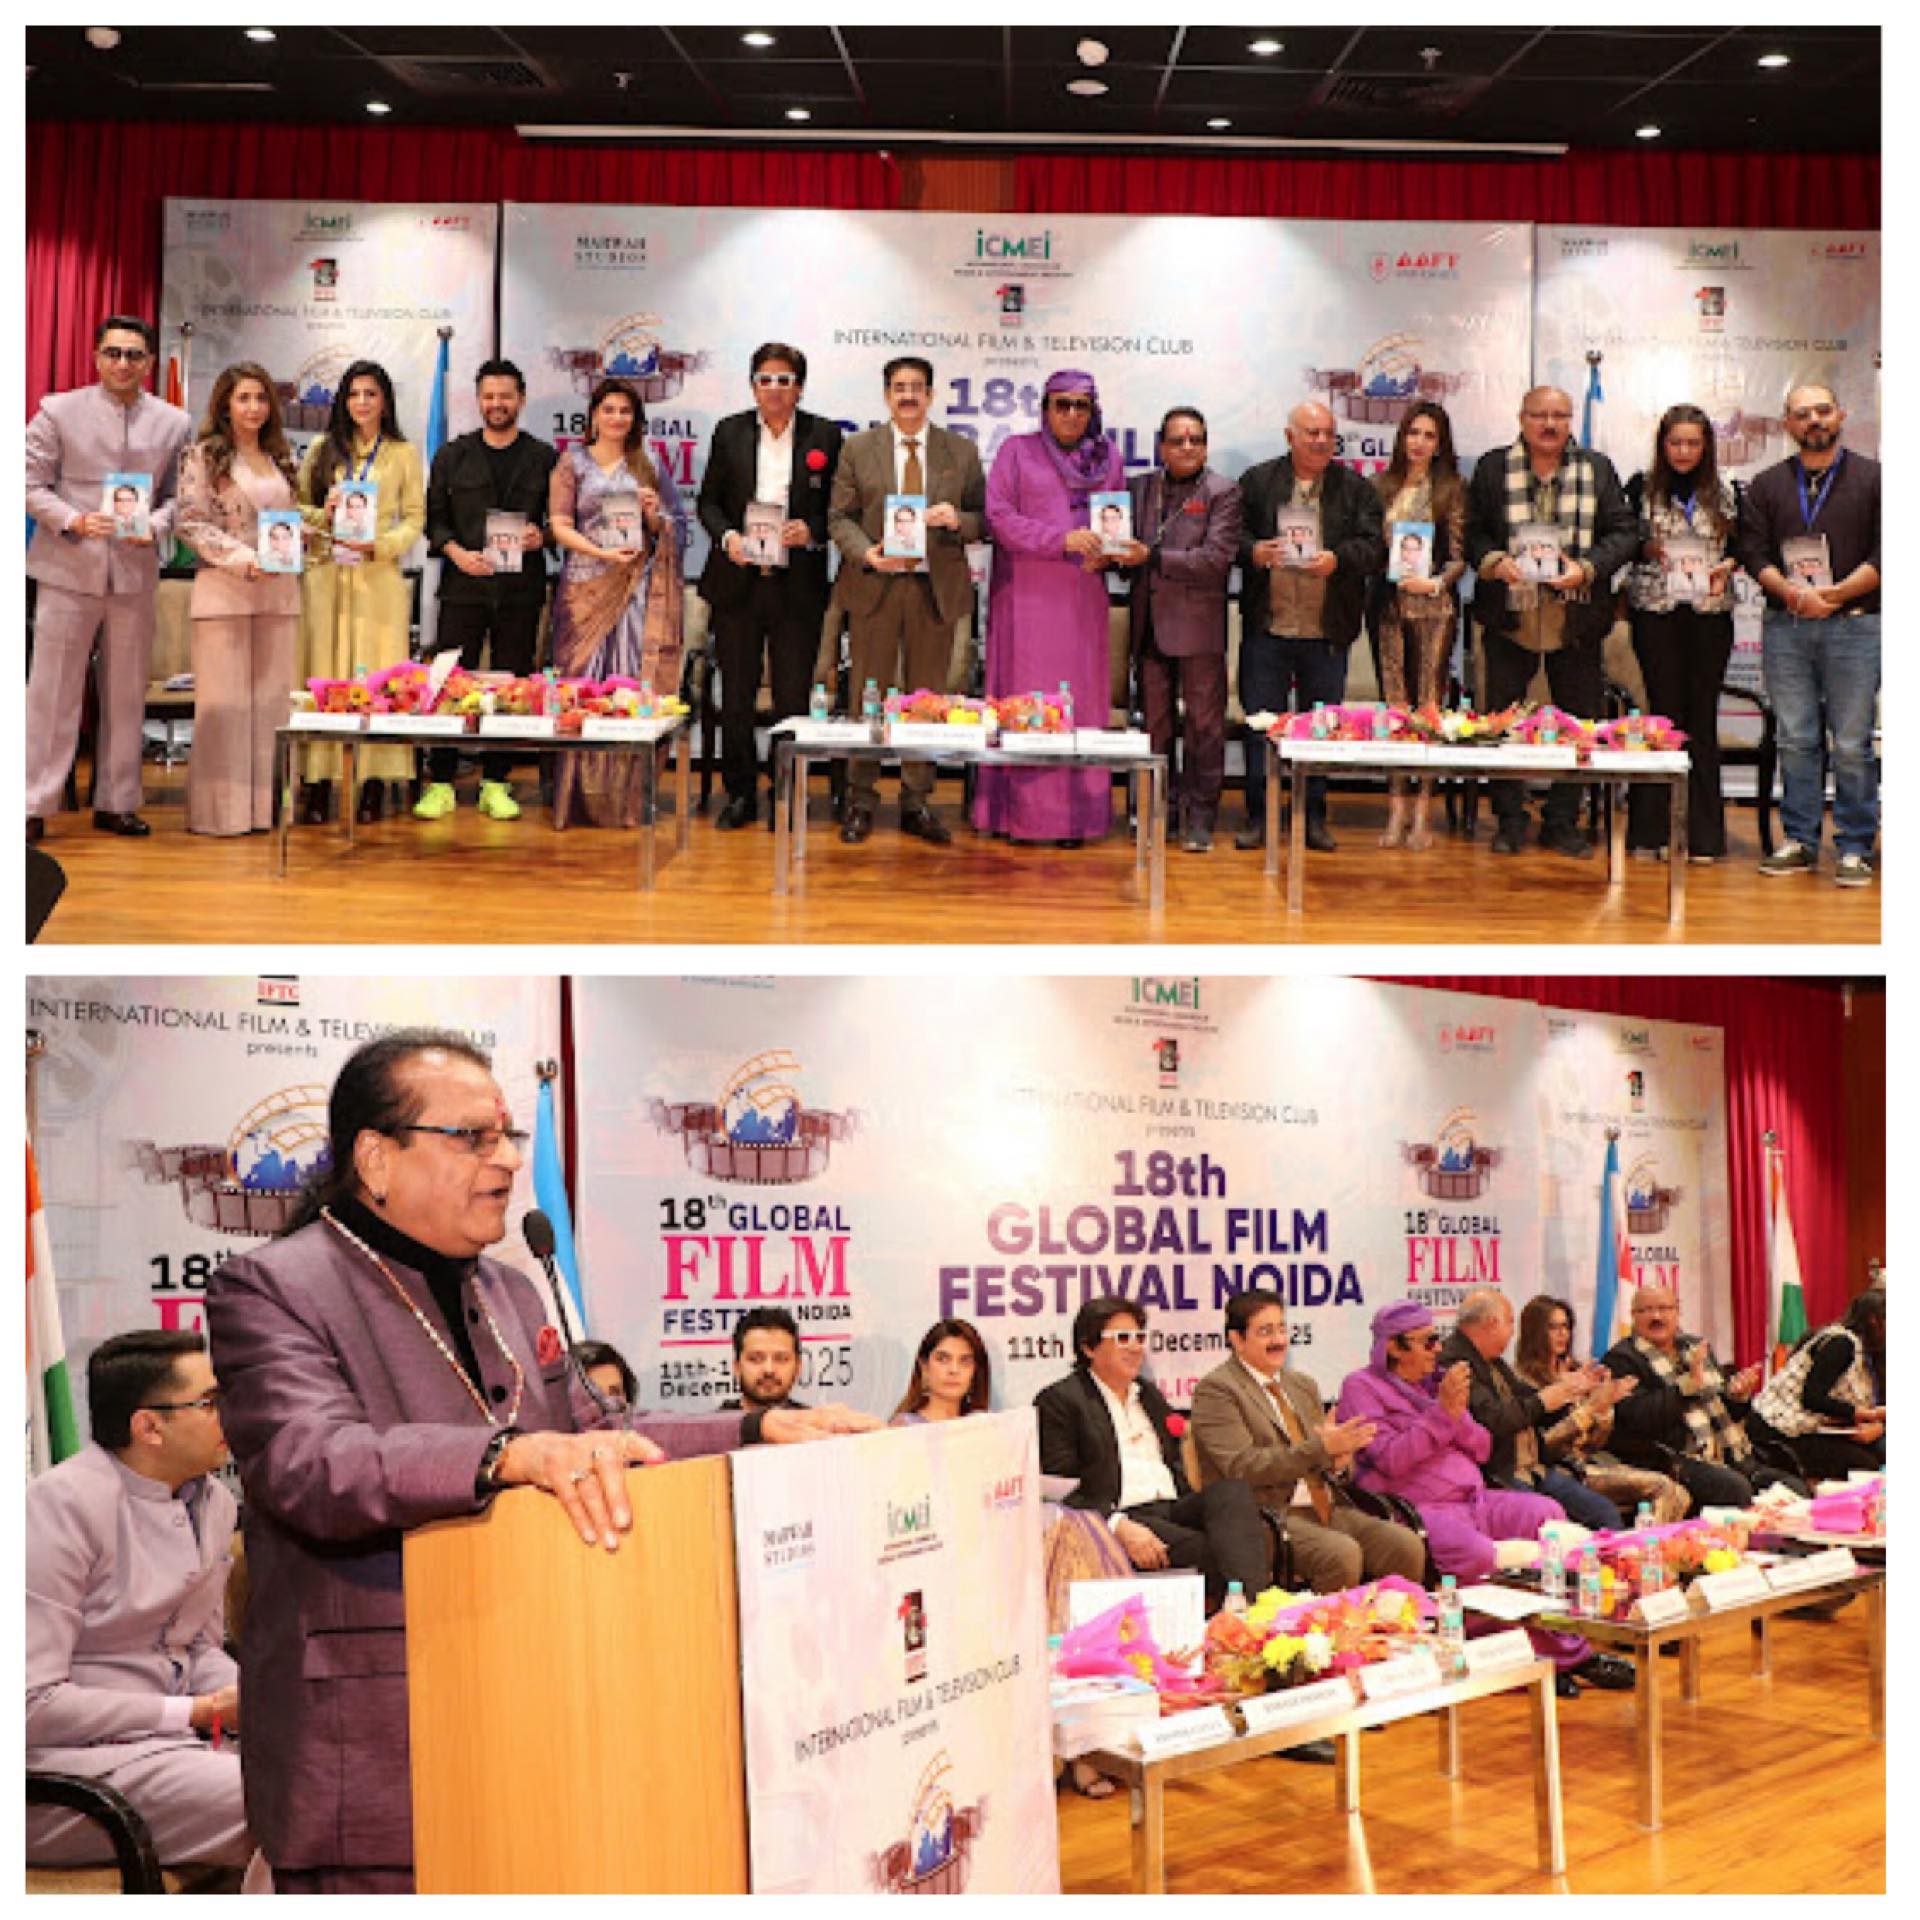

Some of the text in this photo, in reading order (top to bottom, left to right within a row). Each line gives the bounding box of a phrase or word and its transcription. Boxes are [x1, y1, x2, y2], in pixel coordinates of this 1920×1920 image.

[1147, 337, 1194, 354] CLUB
[29, 998, 231, 1031] INTERNATIONAL
[238, 1012, 290, 1036] FILM
[295, 1019, 312, 1037] &
[247, 1042, 318, 1058] presents
[1113, 1148, 1227, 1199] 18th
[659, 1195, 852, 1232] 18th GLOBAL
[986, 1202, 1329, 1257] GLOBAL FILM
[1438, 1215, 1502, 1235] GLOBAL
[659, 1234, 852, 1300] FILM
[1405, 1236, 1501, 1284] FILM
[938, 1263, 1365, 1319] FESTIVAL NOIDA
[797, 1303, 852, 1321] NOIDA
